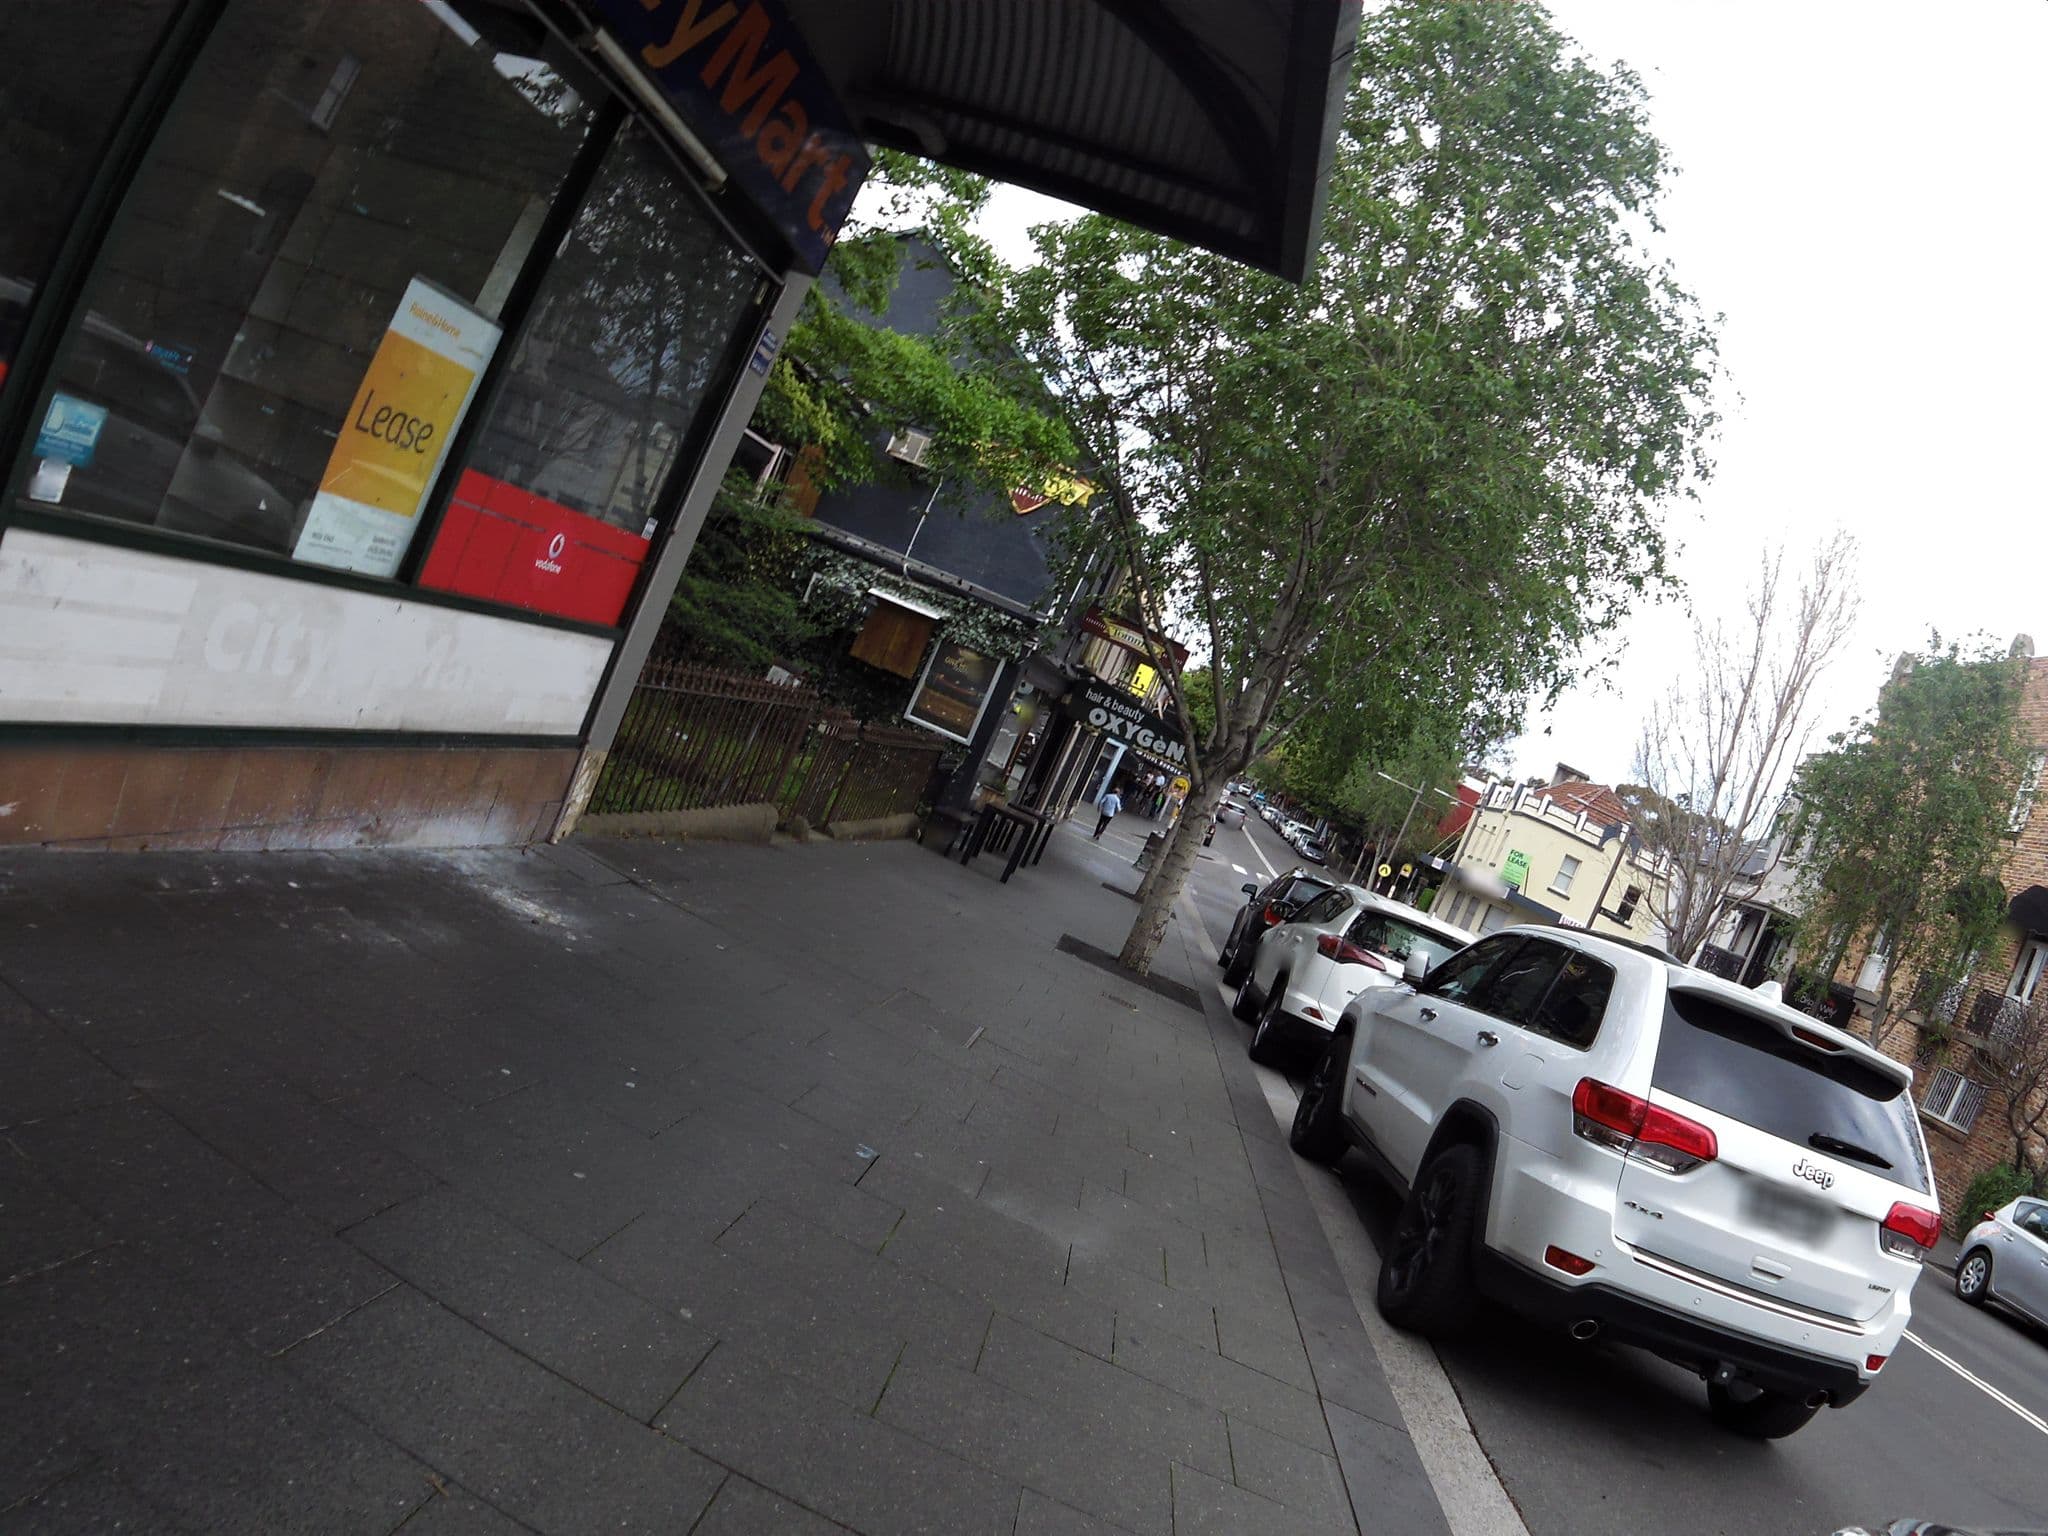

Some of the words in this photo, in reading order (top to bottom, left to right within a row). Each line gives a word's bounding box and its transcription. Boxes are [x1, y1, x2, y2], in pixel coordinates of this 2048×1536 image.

[355, 389, 434, 454] Lease
[535, 558, 562, 575] vodafone
[1086, 688, 1104, 704] hair
[1104, 697, 1112, 708] &
[1111, 702, 1145, 723] beauty
[1507, 856, 1528, 869] LEASE
[1510, 849, 1524, 860] FOR
[1793, 1158, 1835, 1191] Jeep
